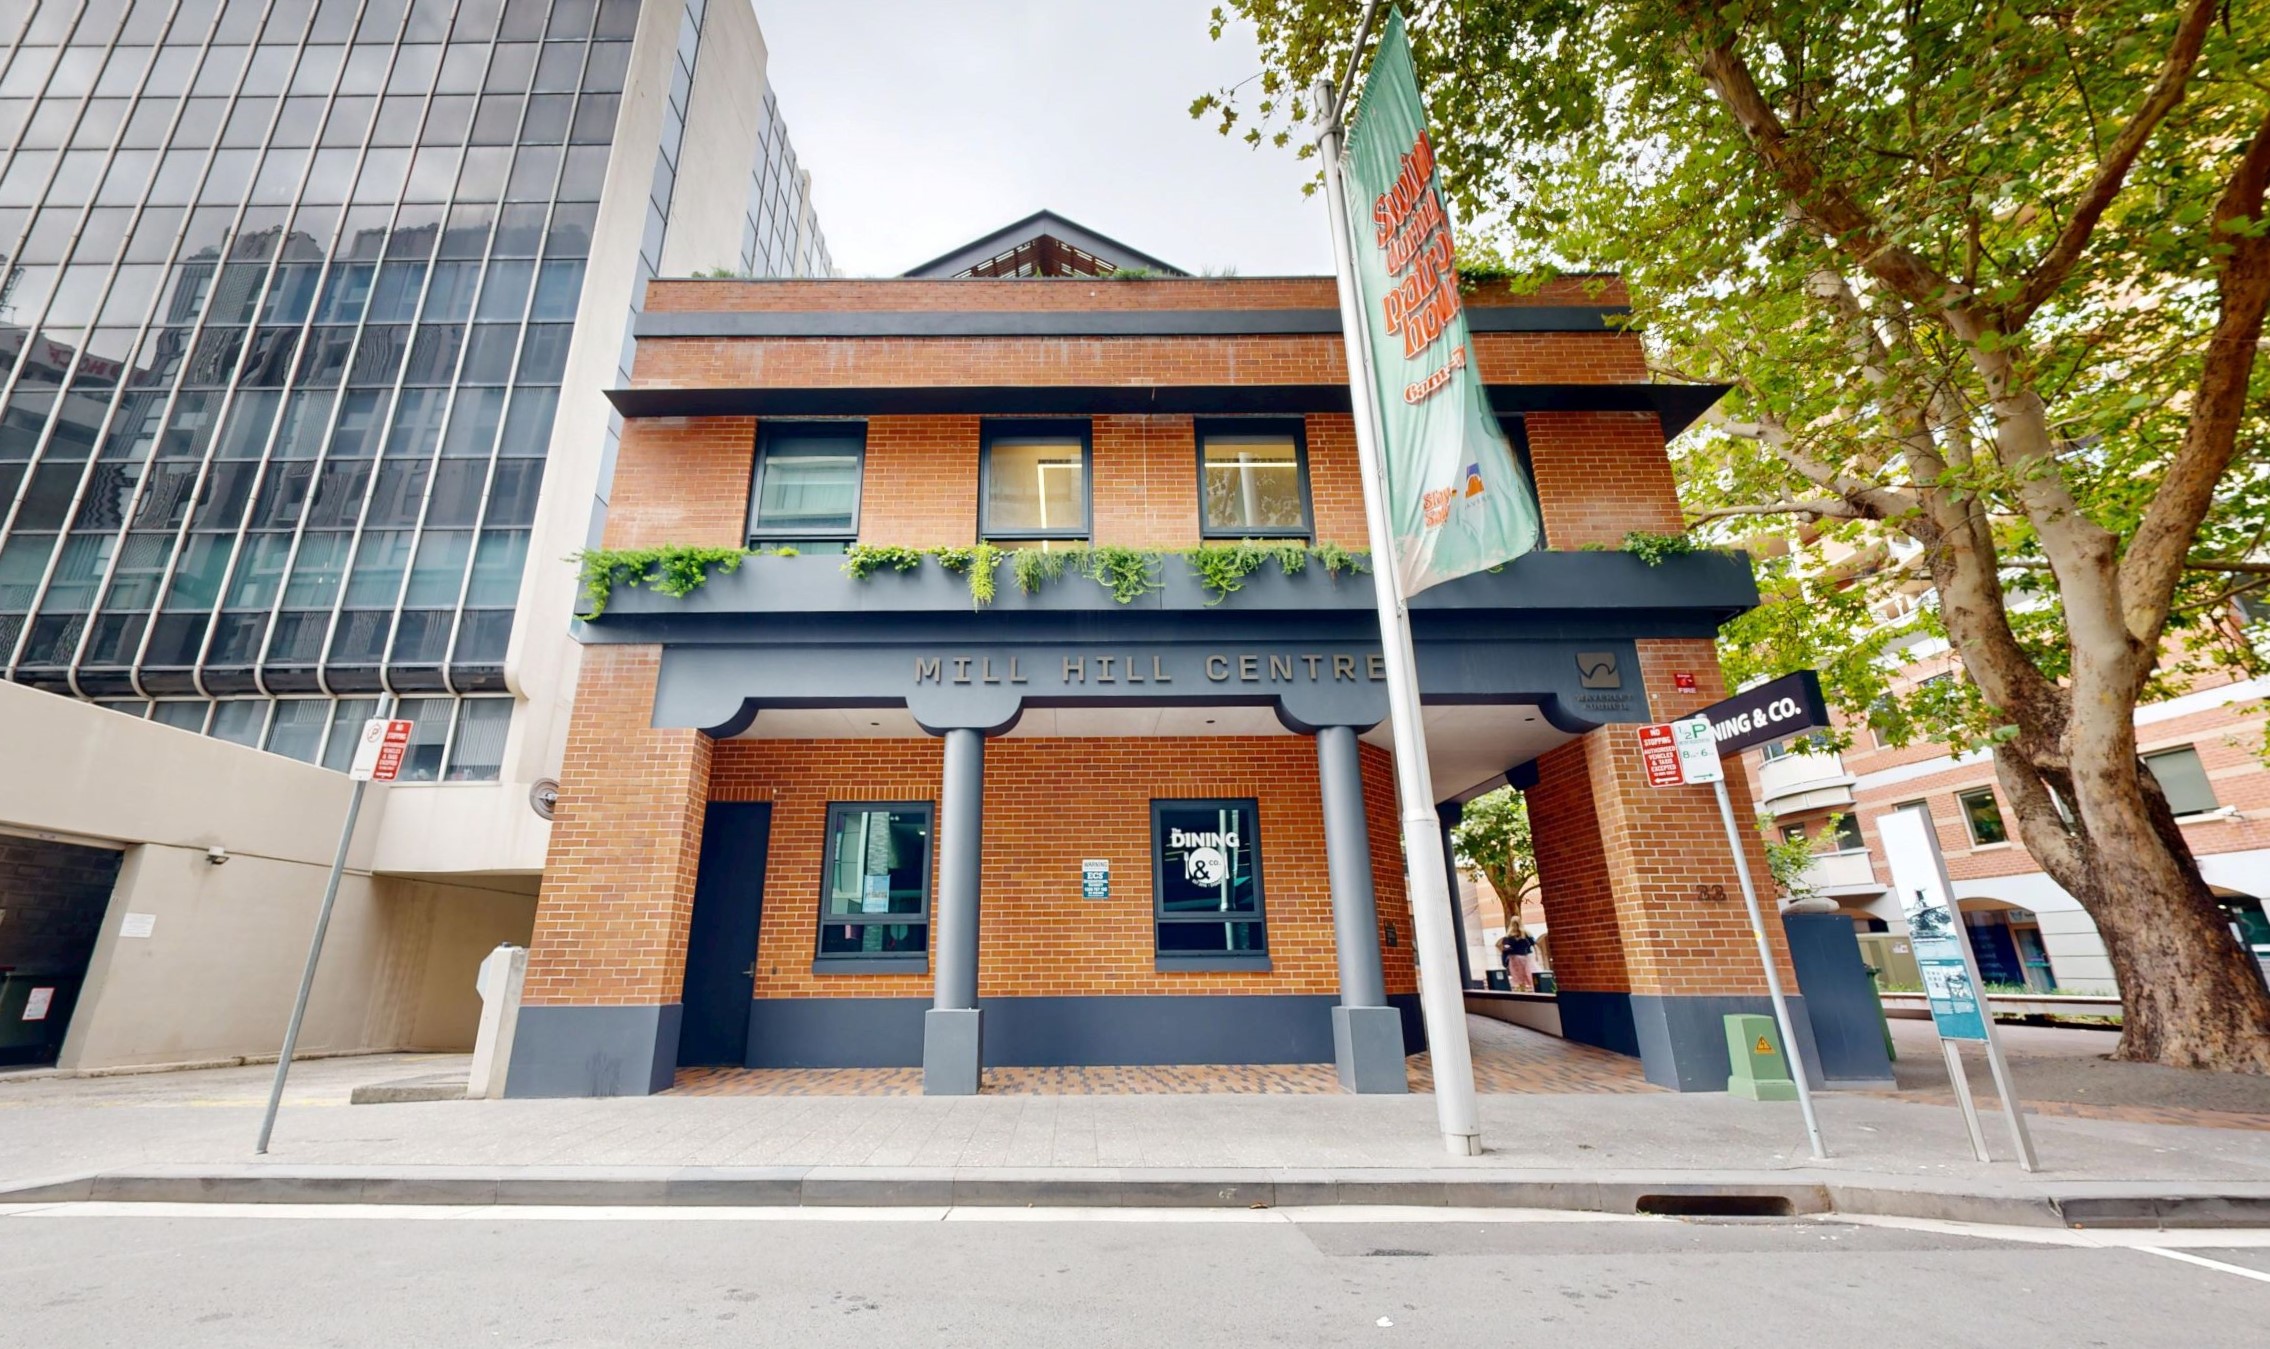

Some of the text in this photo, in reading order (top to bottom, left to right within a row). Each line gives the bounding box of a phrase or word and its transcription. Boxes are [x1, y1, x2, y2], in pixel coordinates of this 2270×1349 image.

[915, 654, 1386, 683] MILL HILL CENTRE
[1711, 697, 1802, 741] NING & CO.
[1649, 729, 1661, 737] NO
[1171, 832, 1240, 848] DINING
[1193, 860, 1211, 880] &
